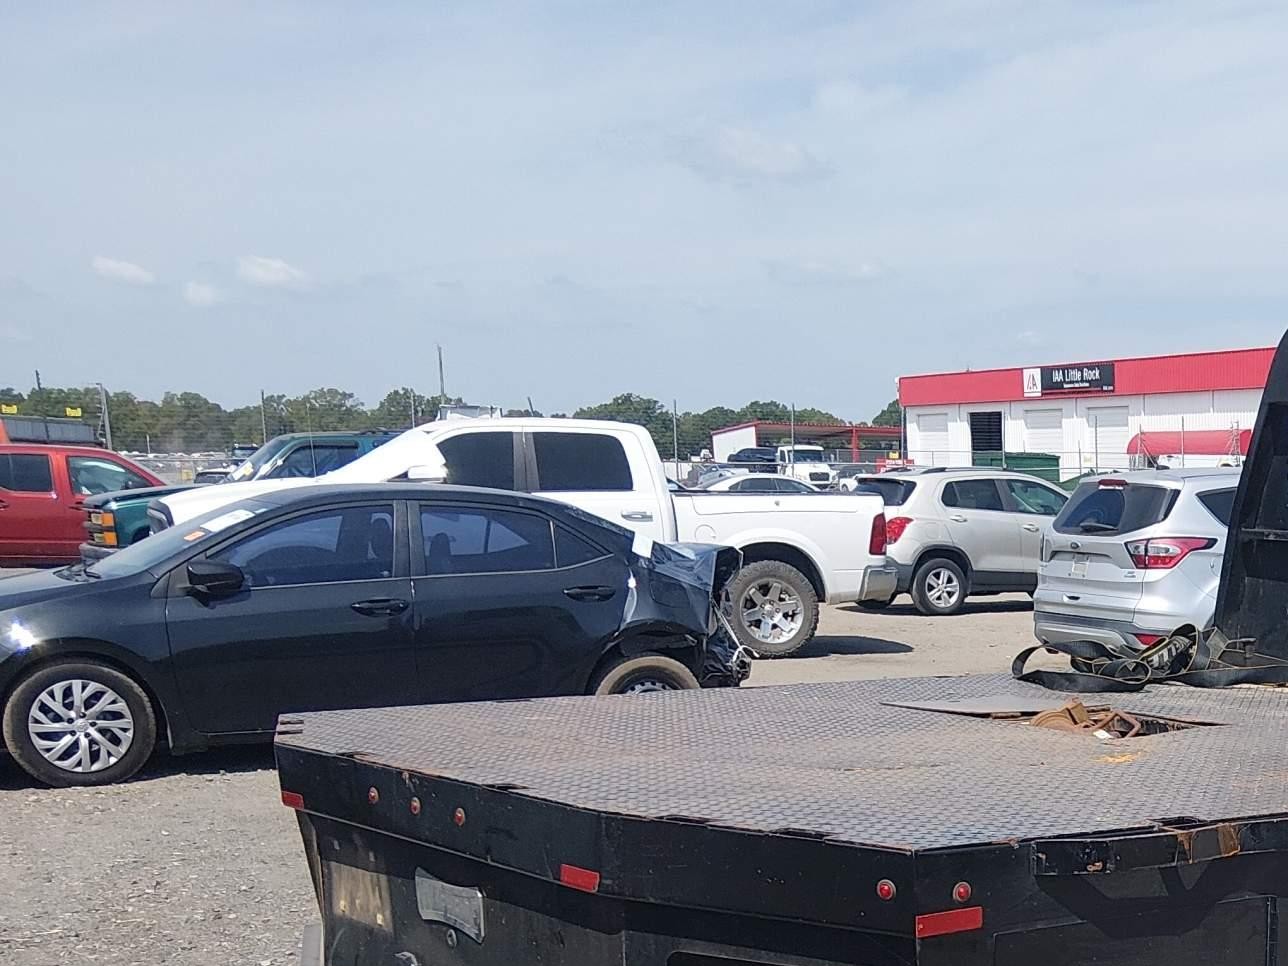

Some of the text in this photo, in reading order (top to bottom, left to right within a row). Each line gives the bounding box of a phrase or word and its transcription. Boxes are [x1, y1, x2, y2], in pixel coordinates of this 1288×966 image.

[1052, 370, 1064, 382] IAA
[1065, 368, 1081, 382] Little
[1083, 367, 1100, 380] Rock
